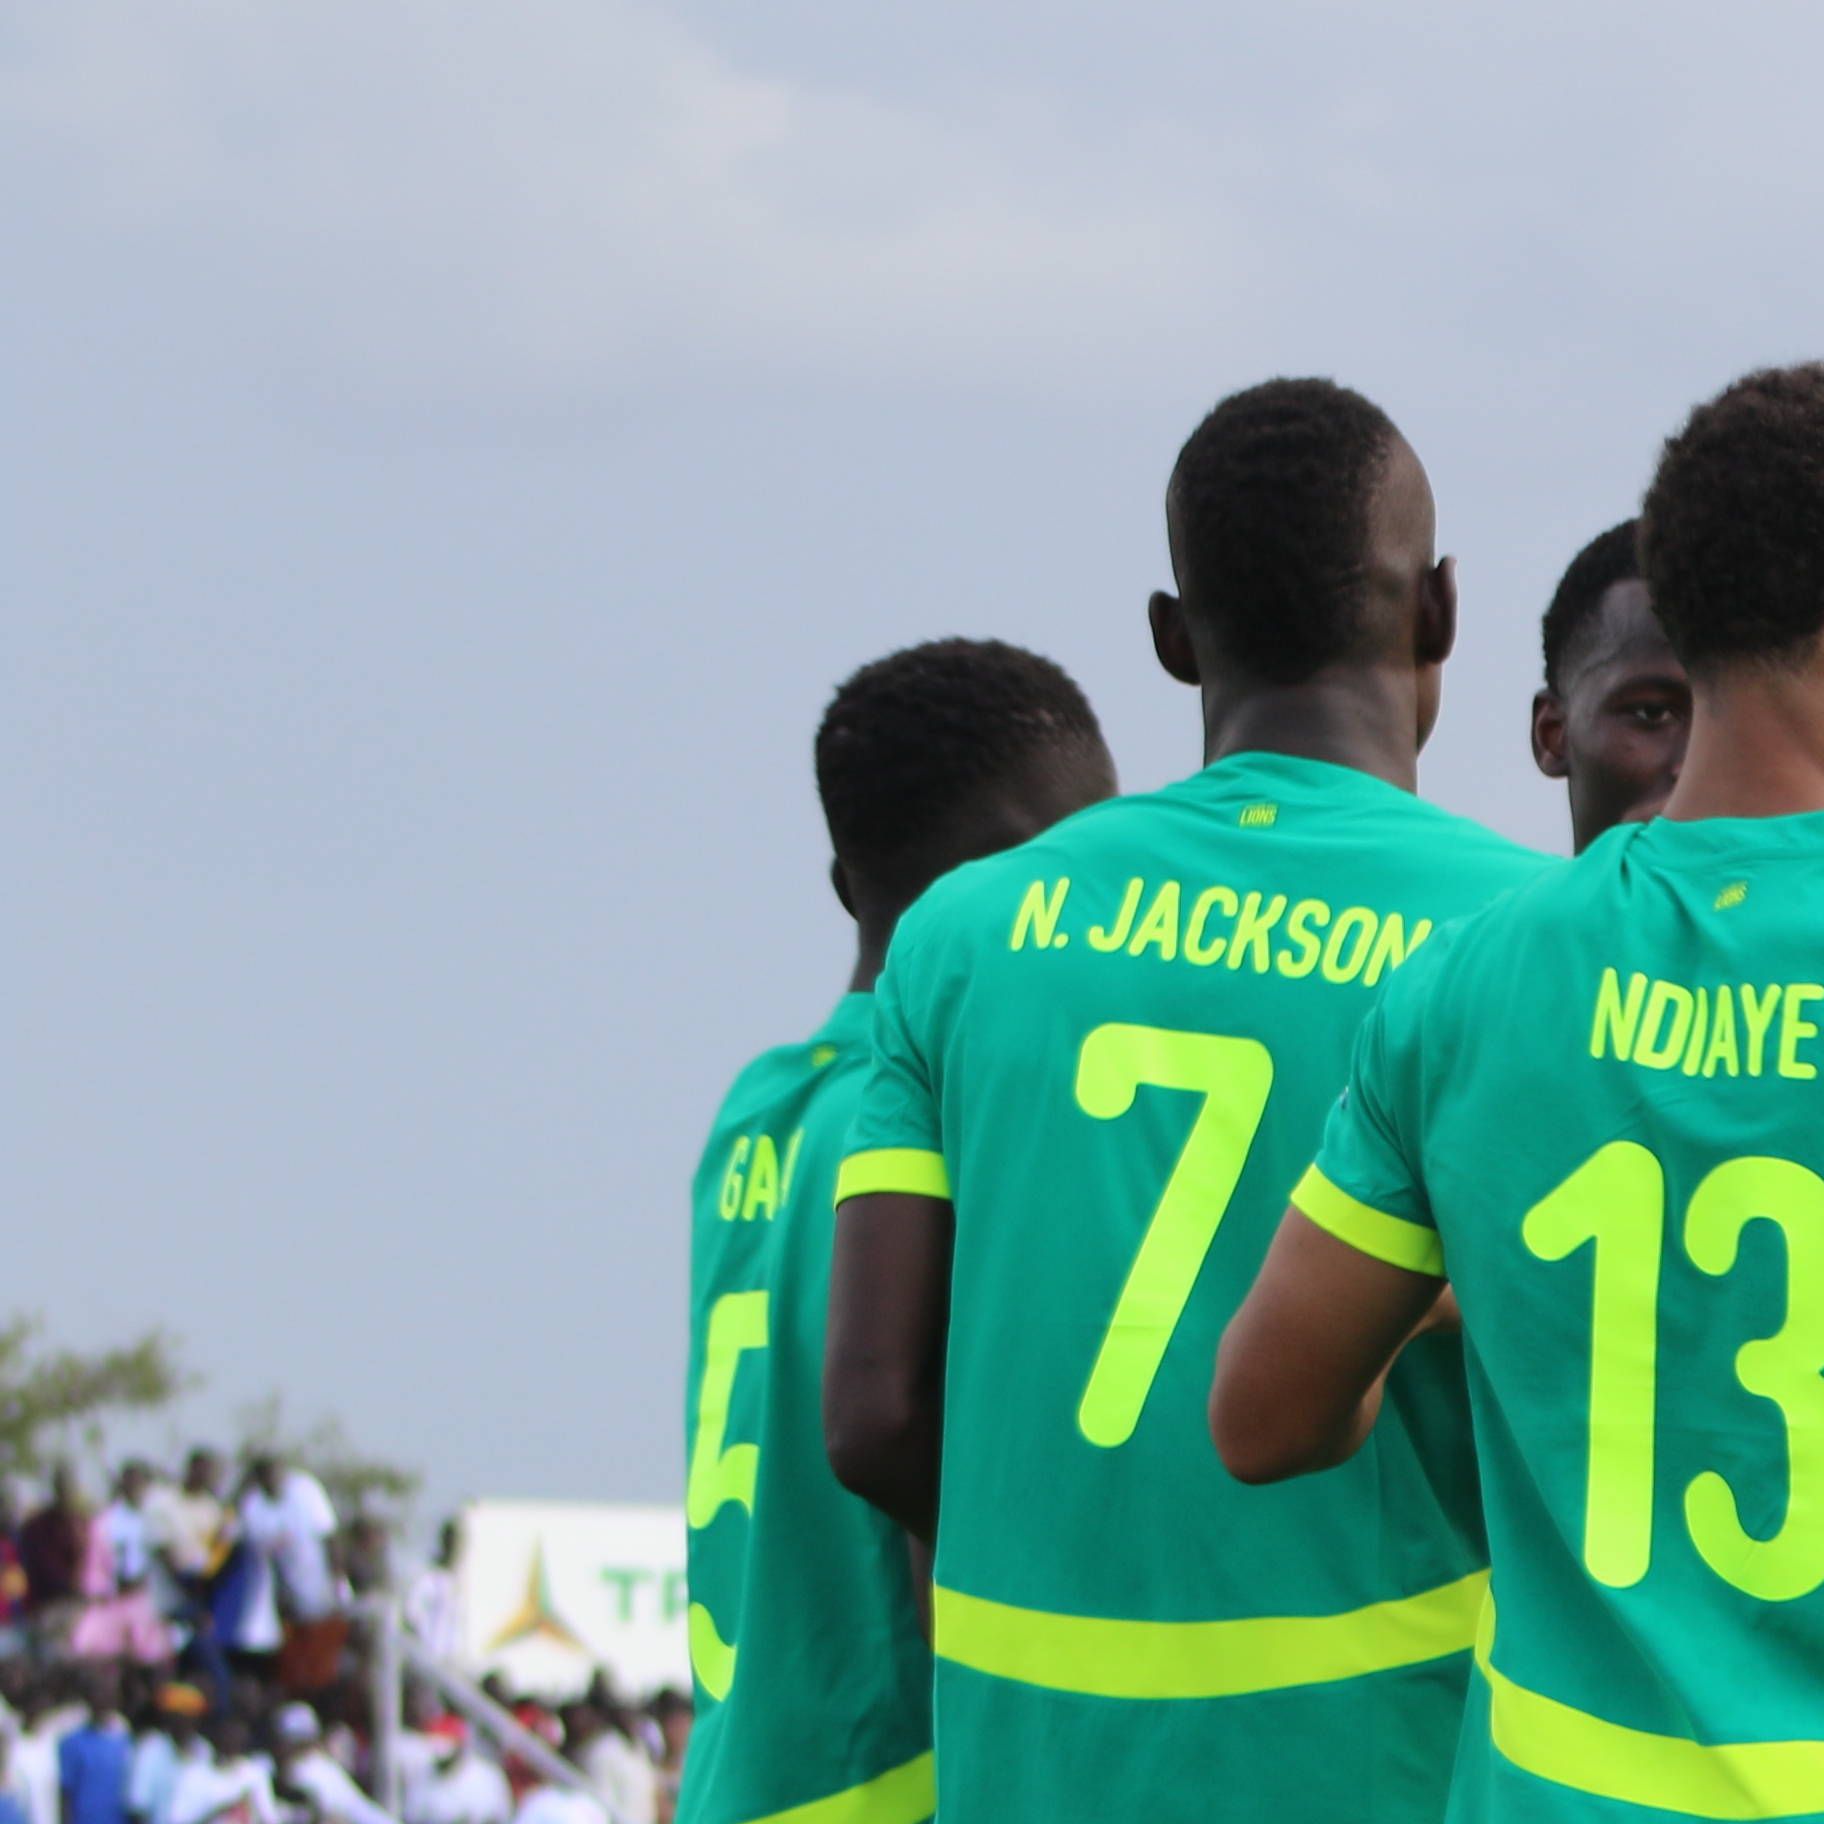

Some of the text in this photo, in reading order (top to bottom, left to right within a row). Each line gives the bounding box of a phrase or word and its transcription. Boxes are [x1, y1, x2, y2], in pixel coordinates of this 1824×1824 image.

[1010, 876, 1433, 988] N. JACKSON
[1076, 1022, 1274, 1448] 7
